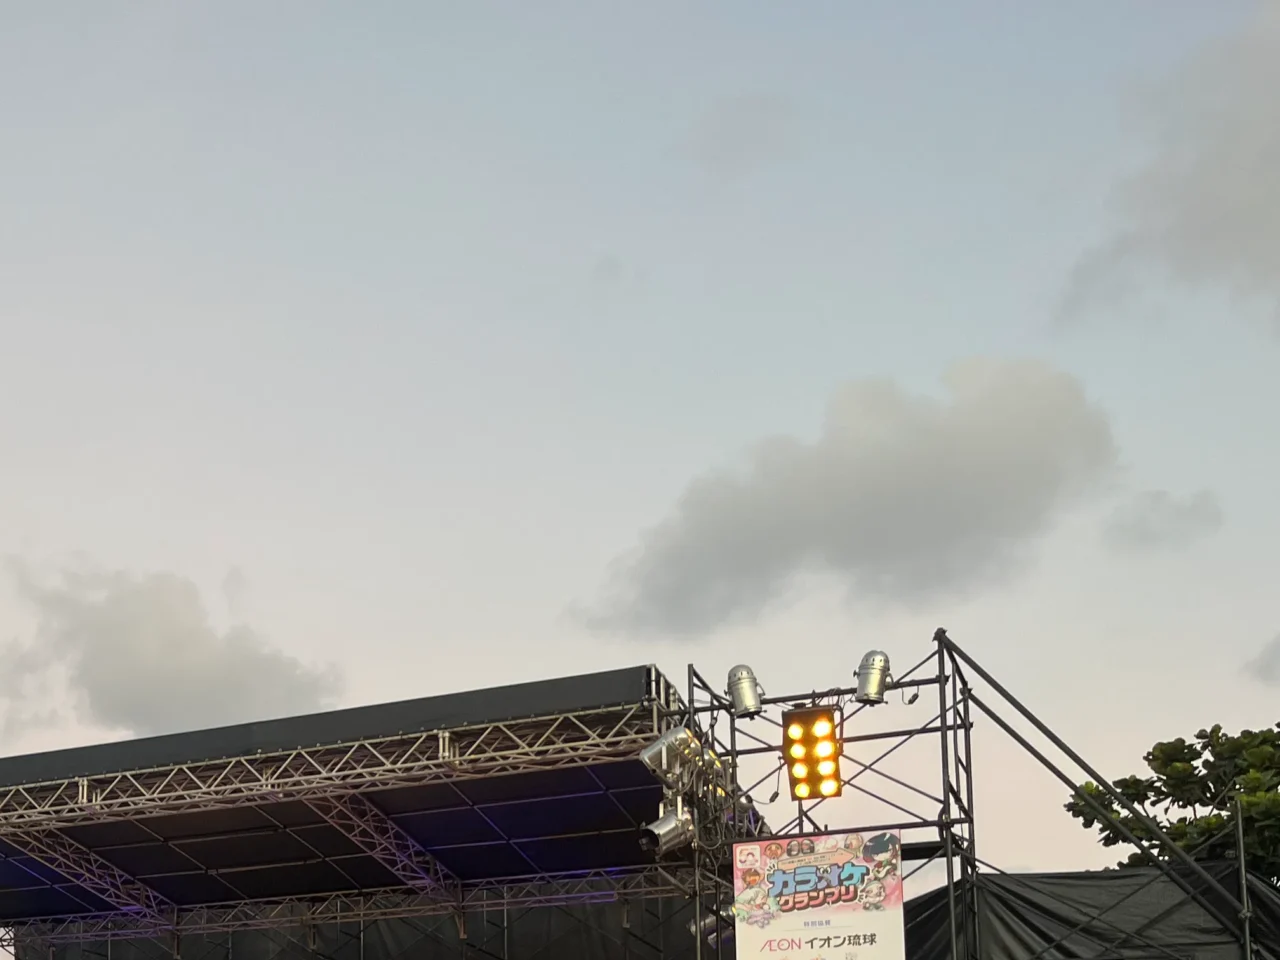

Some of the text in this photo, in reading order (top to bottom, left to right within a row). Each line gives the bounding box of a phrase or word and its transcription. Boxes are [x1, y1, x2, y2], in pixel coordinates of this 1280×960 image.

[768, 862, 870, 896] カラオケ
[778, 885, 858, 912] グランプリ
[805, 933, 877, 949] イオン琉球
